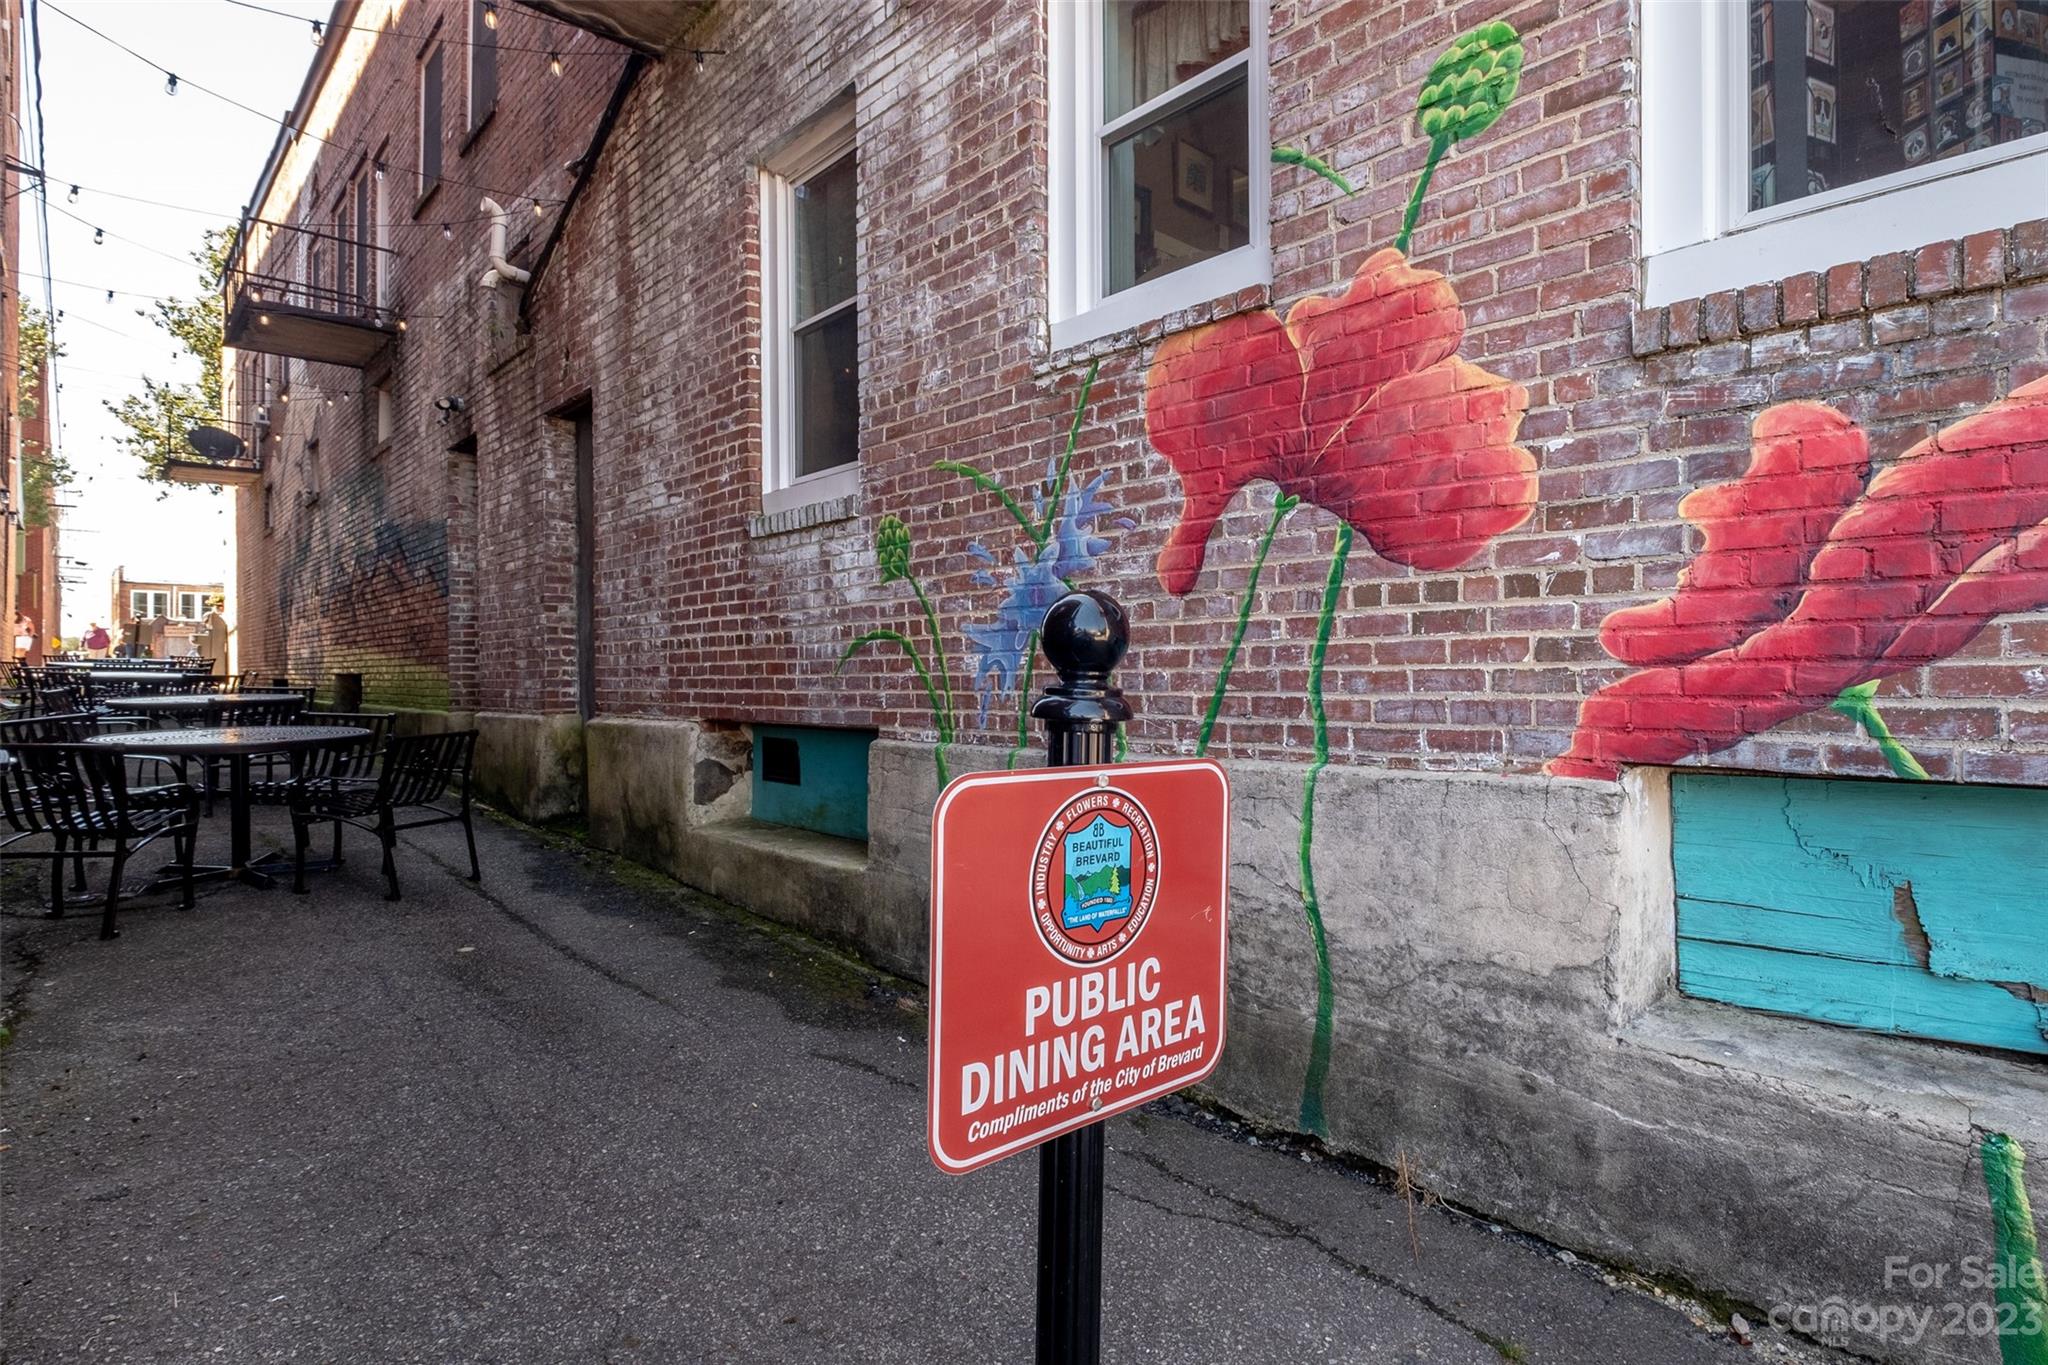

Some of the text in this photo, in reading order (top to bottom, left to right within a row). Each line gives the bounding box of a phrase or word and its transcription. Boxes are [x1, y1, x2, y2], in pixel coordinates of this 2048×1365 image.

[1066, 795, 1109, 821] FLOWERS
[1122, 802, 1155, 859] RECREATION
[1035, 833, 1057, 895] INDUSTRY
[1072, 838, 1124, 853] BEAUTIFUL
[1076, 852, 1120, 867] BREVARD
[1079, 913, 1091, 922] LAND
[1091, 912, 1098, 920] OF
[1127, 878, 1155, 932] EDUCATION
[1040, 912, 1087, 959] OPPORTUNITY
[1096, 939, 1118, 957] ARTS
[1025, 956, 1161, 1037] PUBLIC
[961, 994, 1206, 1116] DINING AREA
[967, 1041, 1204, 1143] Compliments of the City of Brevard
